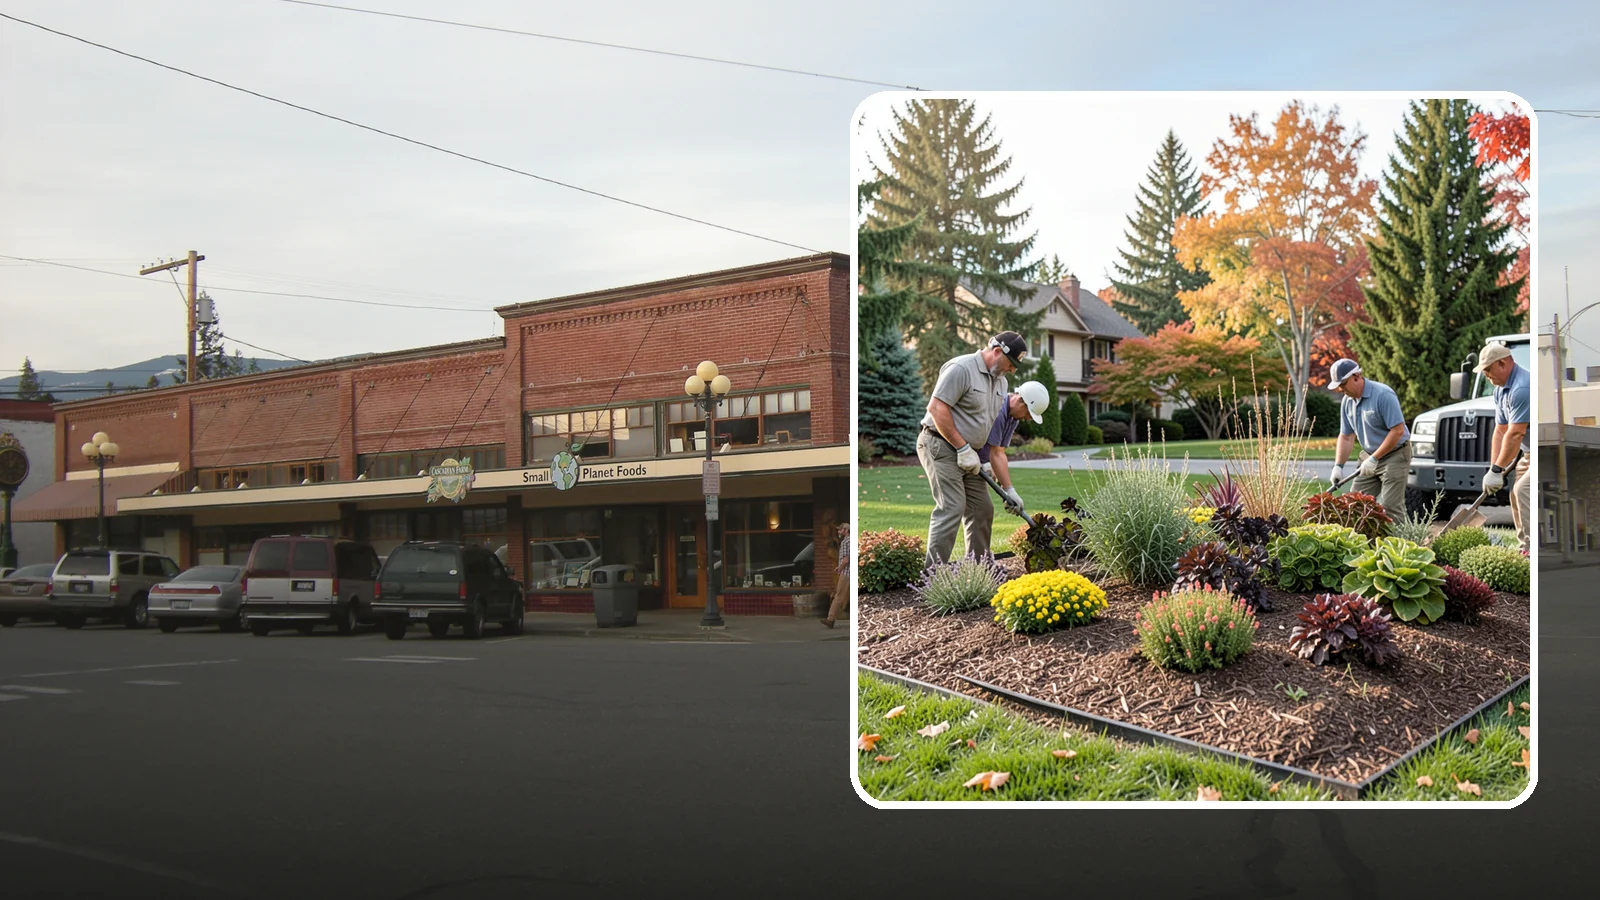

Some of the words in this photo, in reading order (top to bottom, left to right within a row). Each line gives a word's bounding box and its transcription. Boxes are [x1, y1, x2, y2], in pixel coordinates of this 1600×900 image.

[523, 470, 549, 483] Small
[582, 467, 614, 479] Planet
[617, 464, 647, 477] Foods
